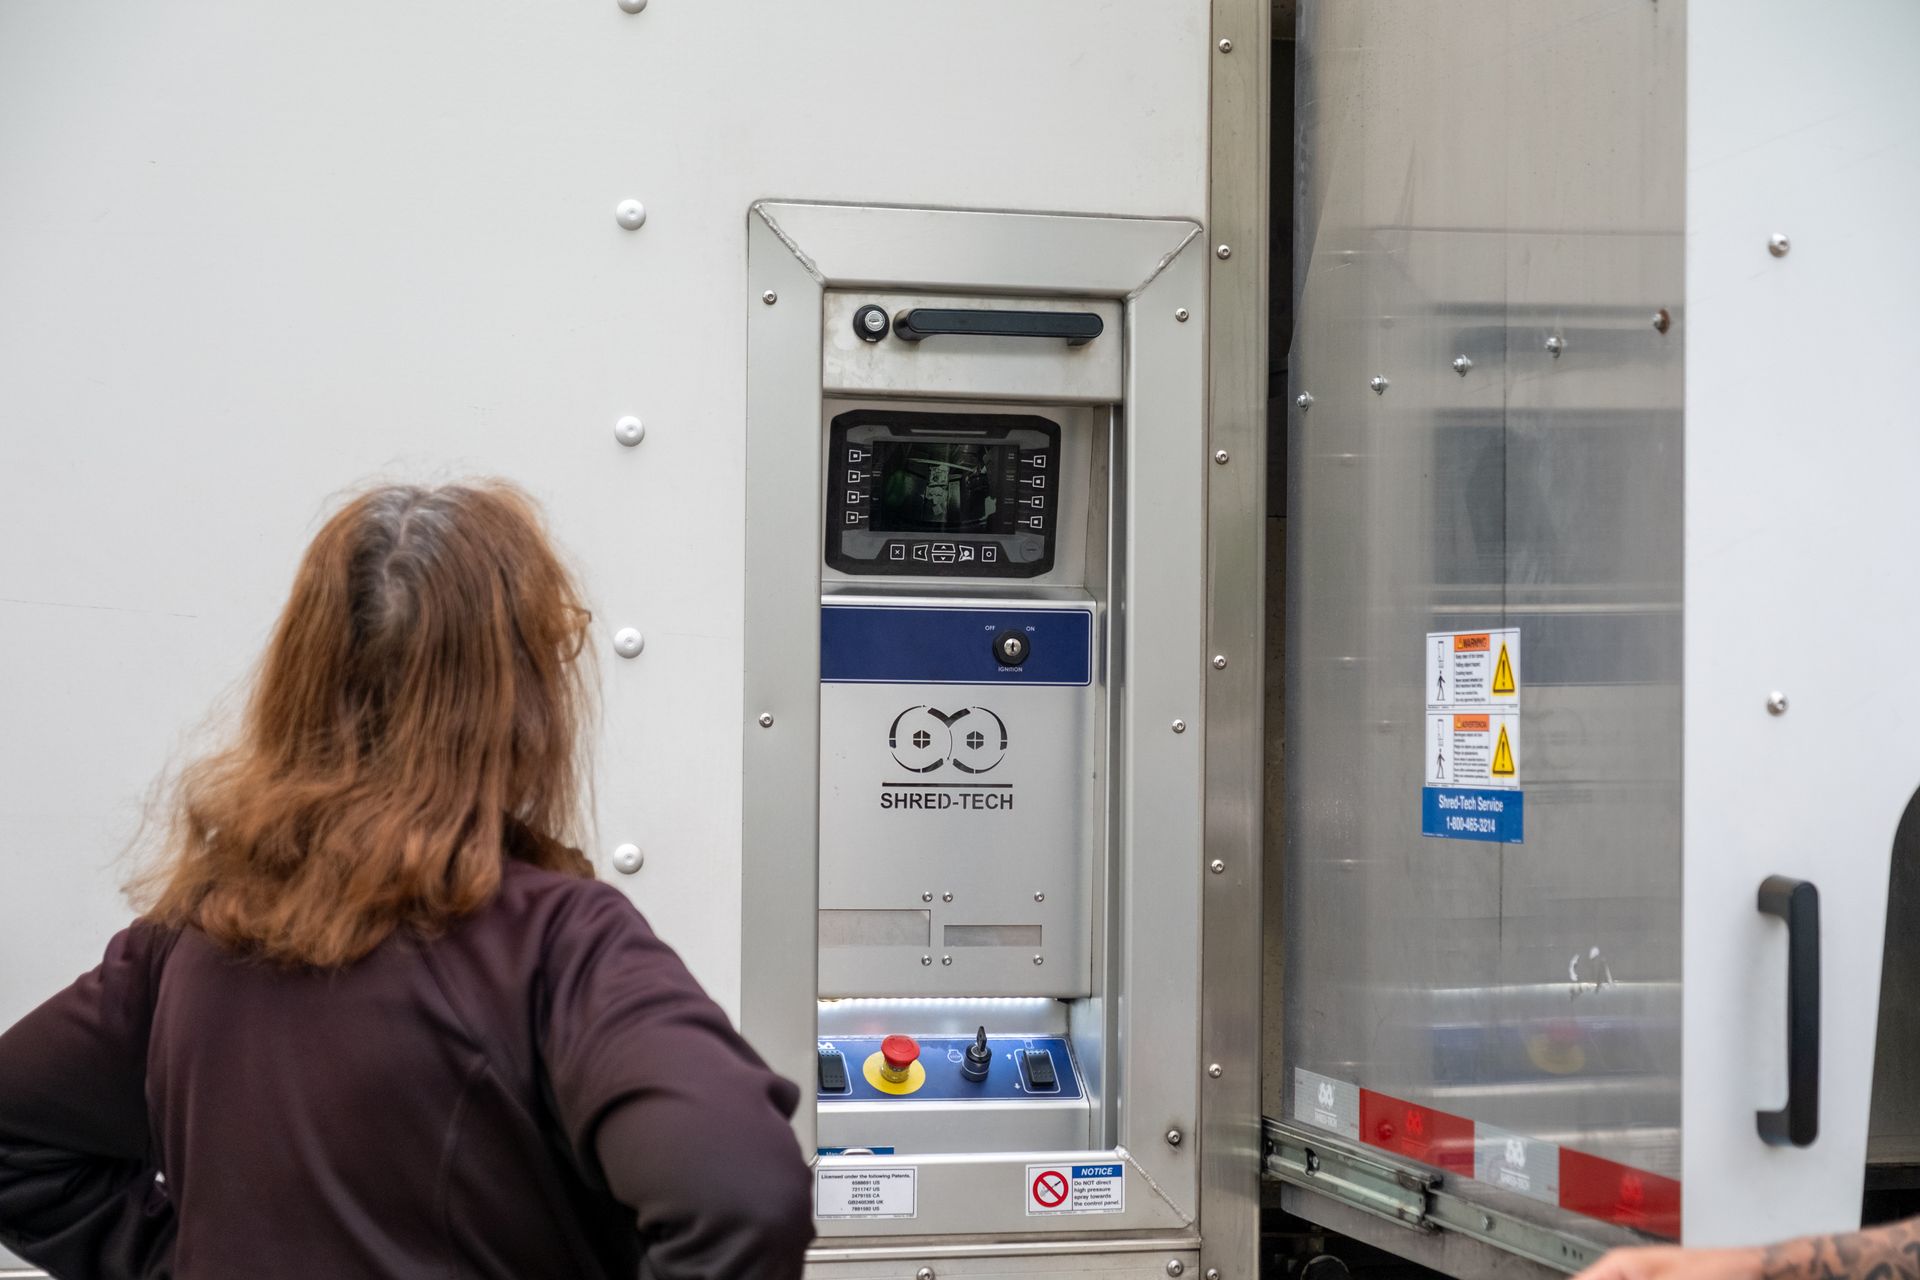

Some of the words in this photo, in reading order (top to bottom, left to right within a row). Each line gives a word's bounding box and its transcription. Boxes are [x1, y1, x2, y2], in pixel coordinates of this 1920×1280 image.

[880, 792, 1013, 810] SHRED-TECH
[1438, 794, 1477, 810] Shred-Tech
[1478, 797, 1504, 812] Service
[1446, 816, 1496, 833] 1-800-465-3214
[1081, 1167, 1113, 1176] NOTICE
